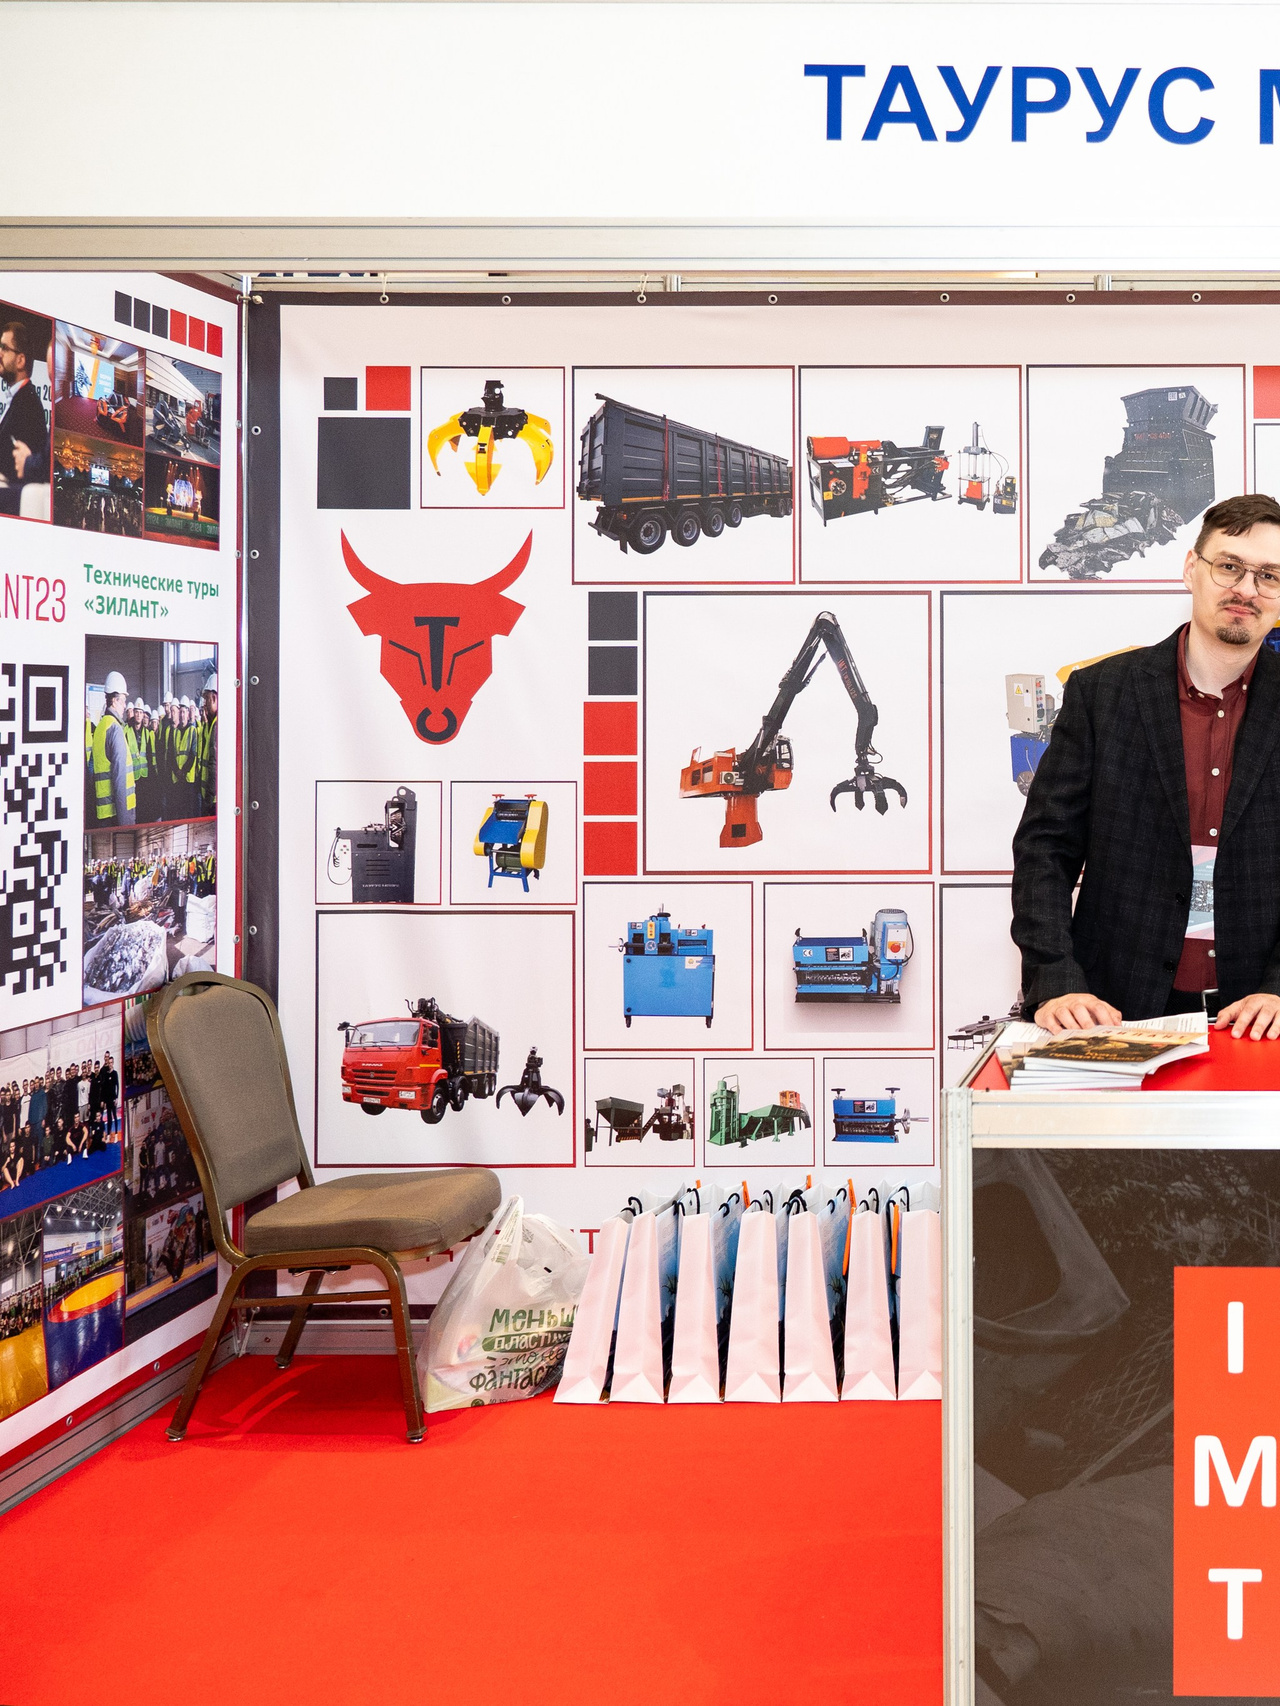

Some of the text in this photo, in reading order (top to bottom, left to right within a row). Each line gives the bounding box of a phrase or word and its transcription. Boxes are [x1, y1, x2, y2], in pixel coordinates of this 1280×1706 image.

[803, 63, 1216, 146] ТАУРУС
[0, 572, 67, 623] NT23
[83, 563, 220, 600] Технические туры
[84, 594, 169, 619] «ЗИЛАНТ»
